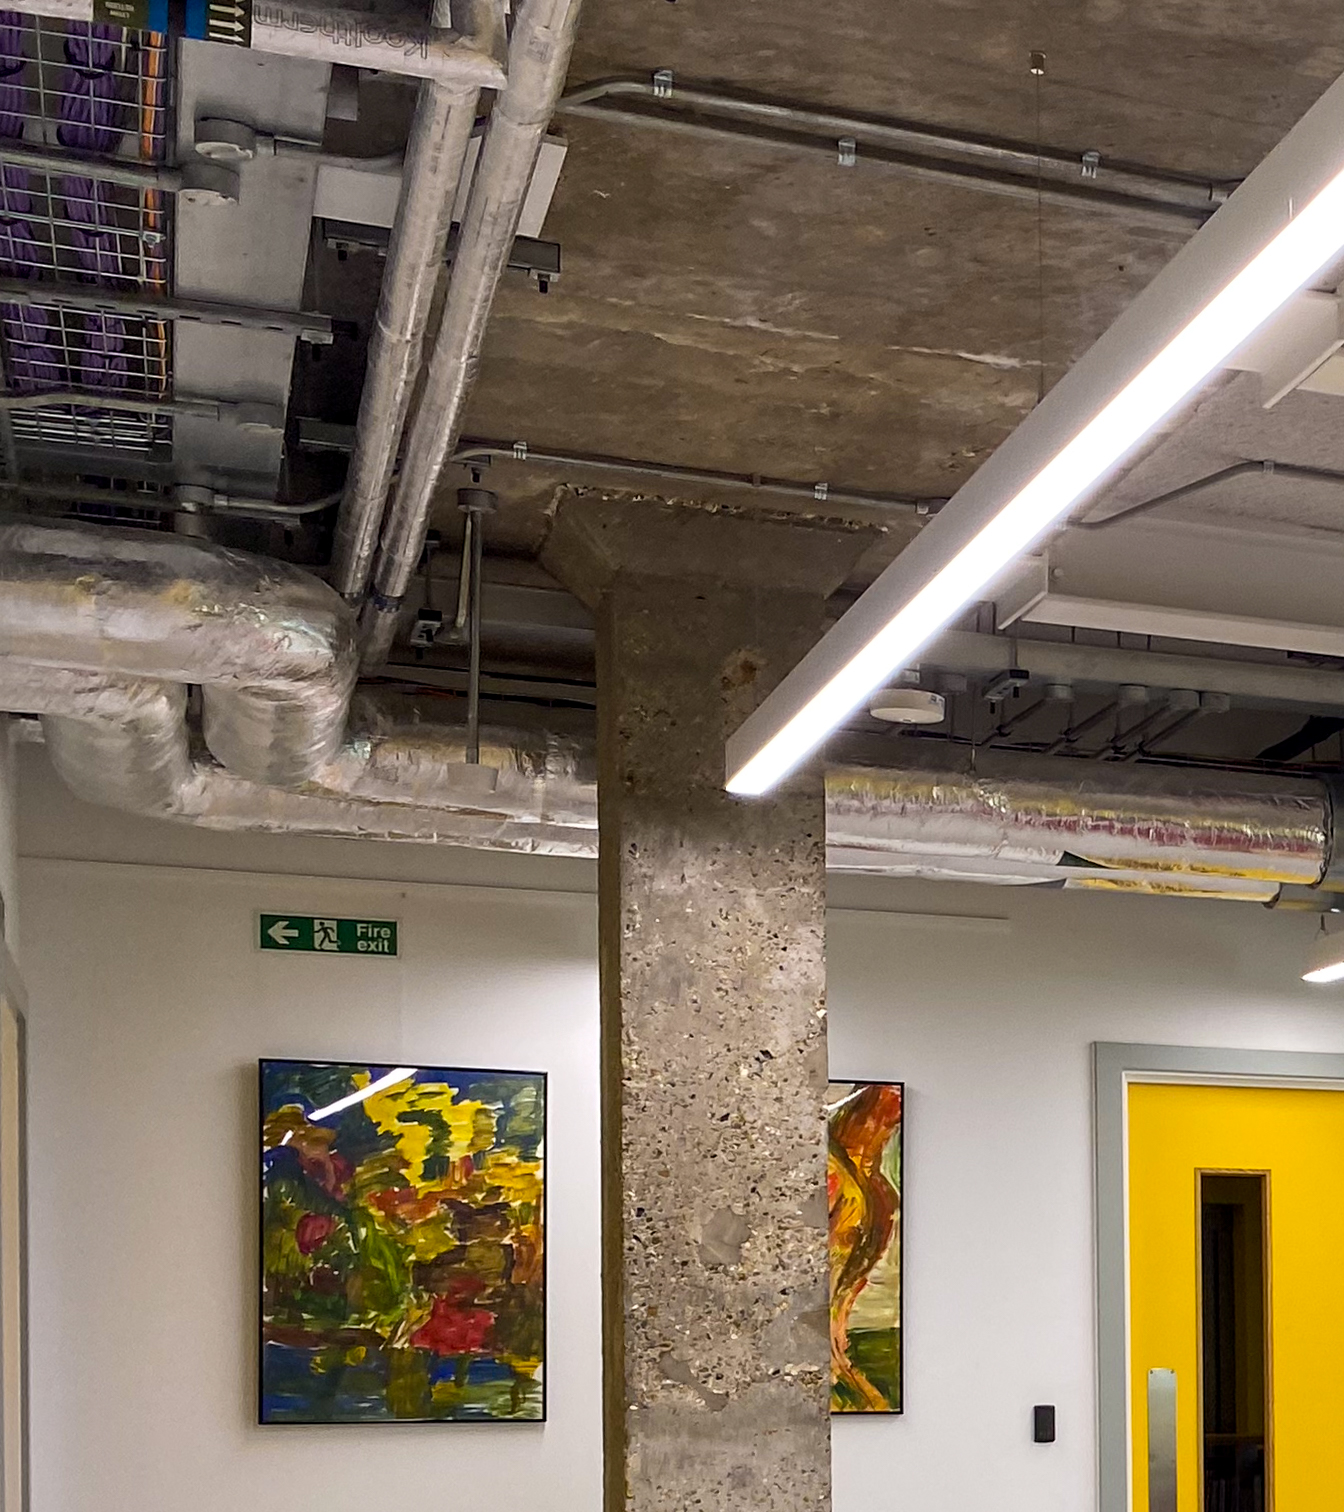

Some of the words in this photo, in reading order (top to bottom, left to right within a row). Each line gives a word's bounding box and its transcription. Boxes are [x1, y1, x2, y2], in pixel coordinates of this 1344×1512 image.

[253, 4, 429, 60] Kooltherm
[356, 923, 392, 939] Fire
[356, 939, 390, 953] exit
